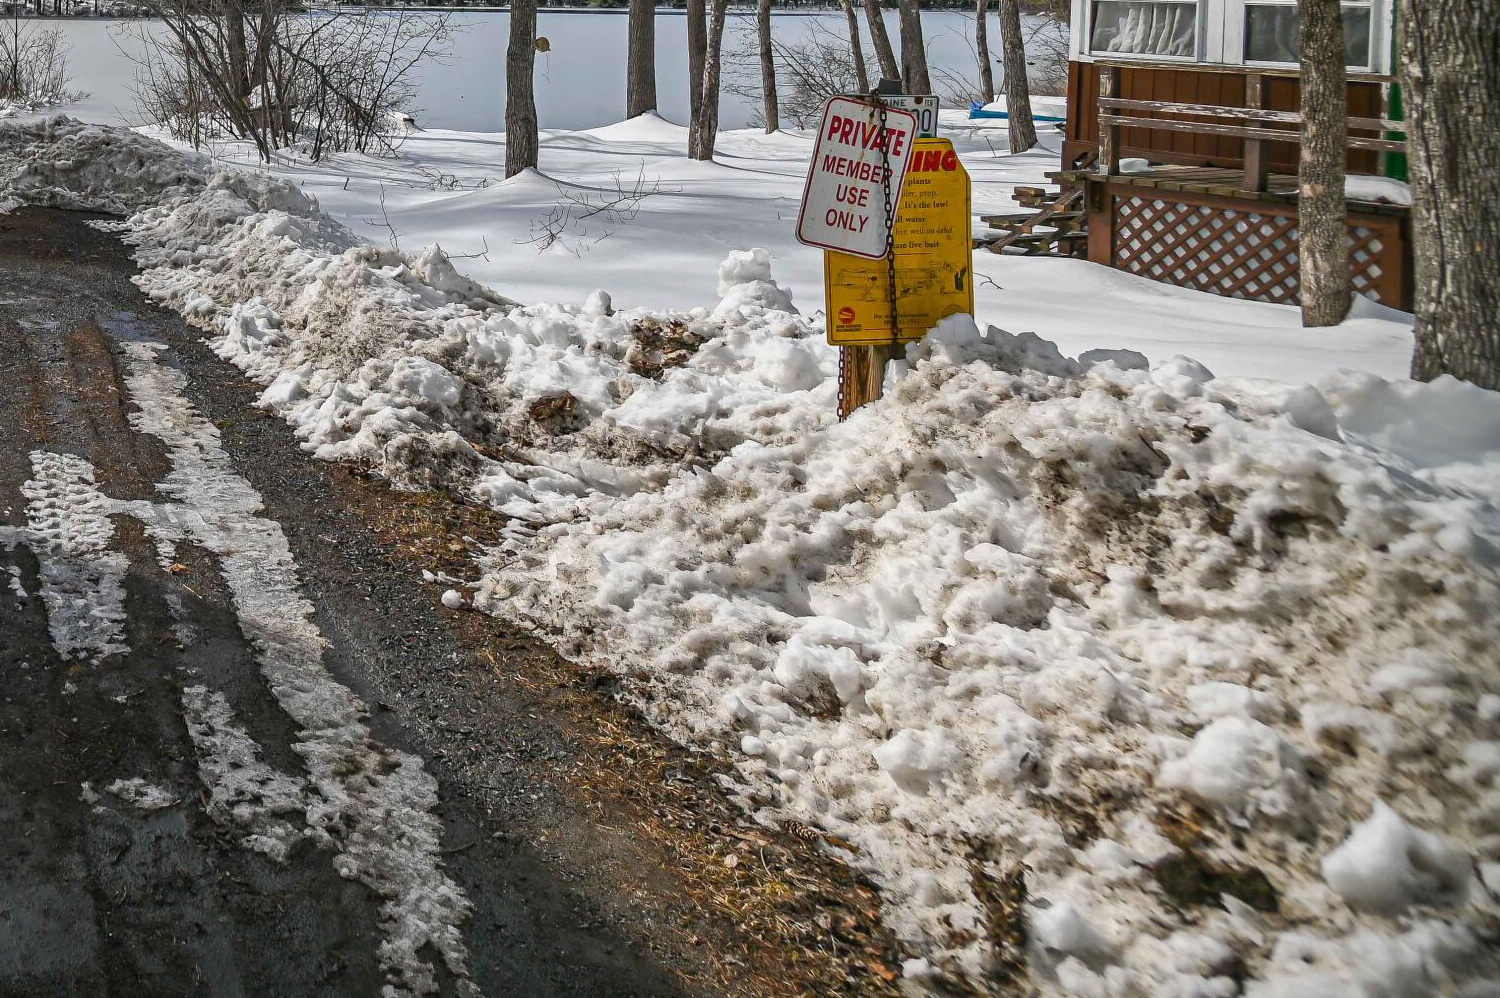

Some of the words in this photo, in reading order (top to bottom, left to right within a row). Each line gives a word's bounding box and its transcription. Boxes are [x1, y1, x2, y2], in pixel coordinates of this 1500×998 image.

[827, 115, 906, 157] PRIVATE
[822, 155, 893, 184] MEMBER
[907, 150, 957, 172] ING
[908, 177, 931, 187] plants
[836, 184, 869, 207] USE
[919, 201, 931, 209] the
[825, 208, 869, 233] ONLY
[909, 240, 923, 248] live
[925, 239, 939, 248] bait
